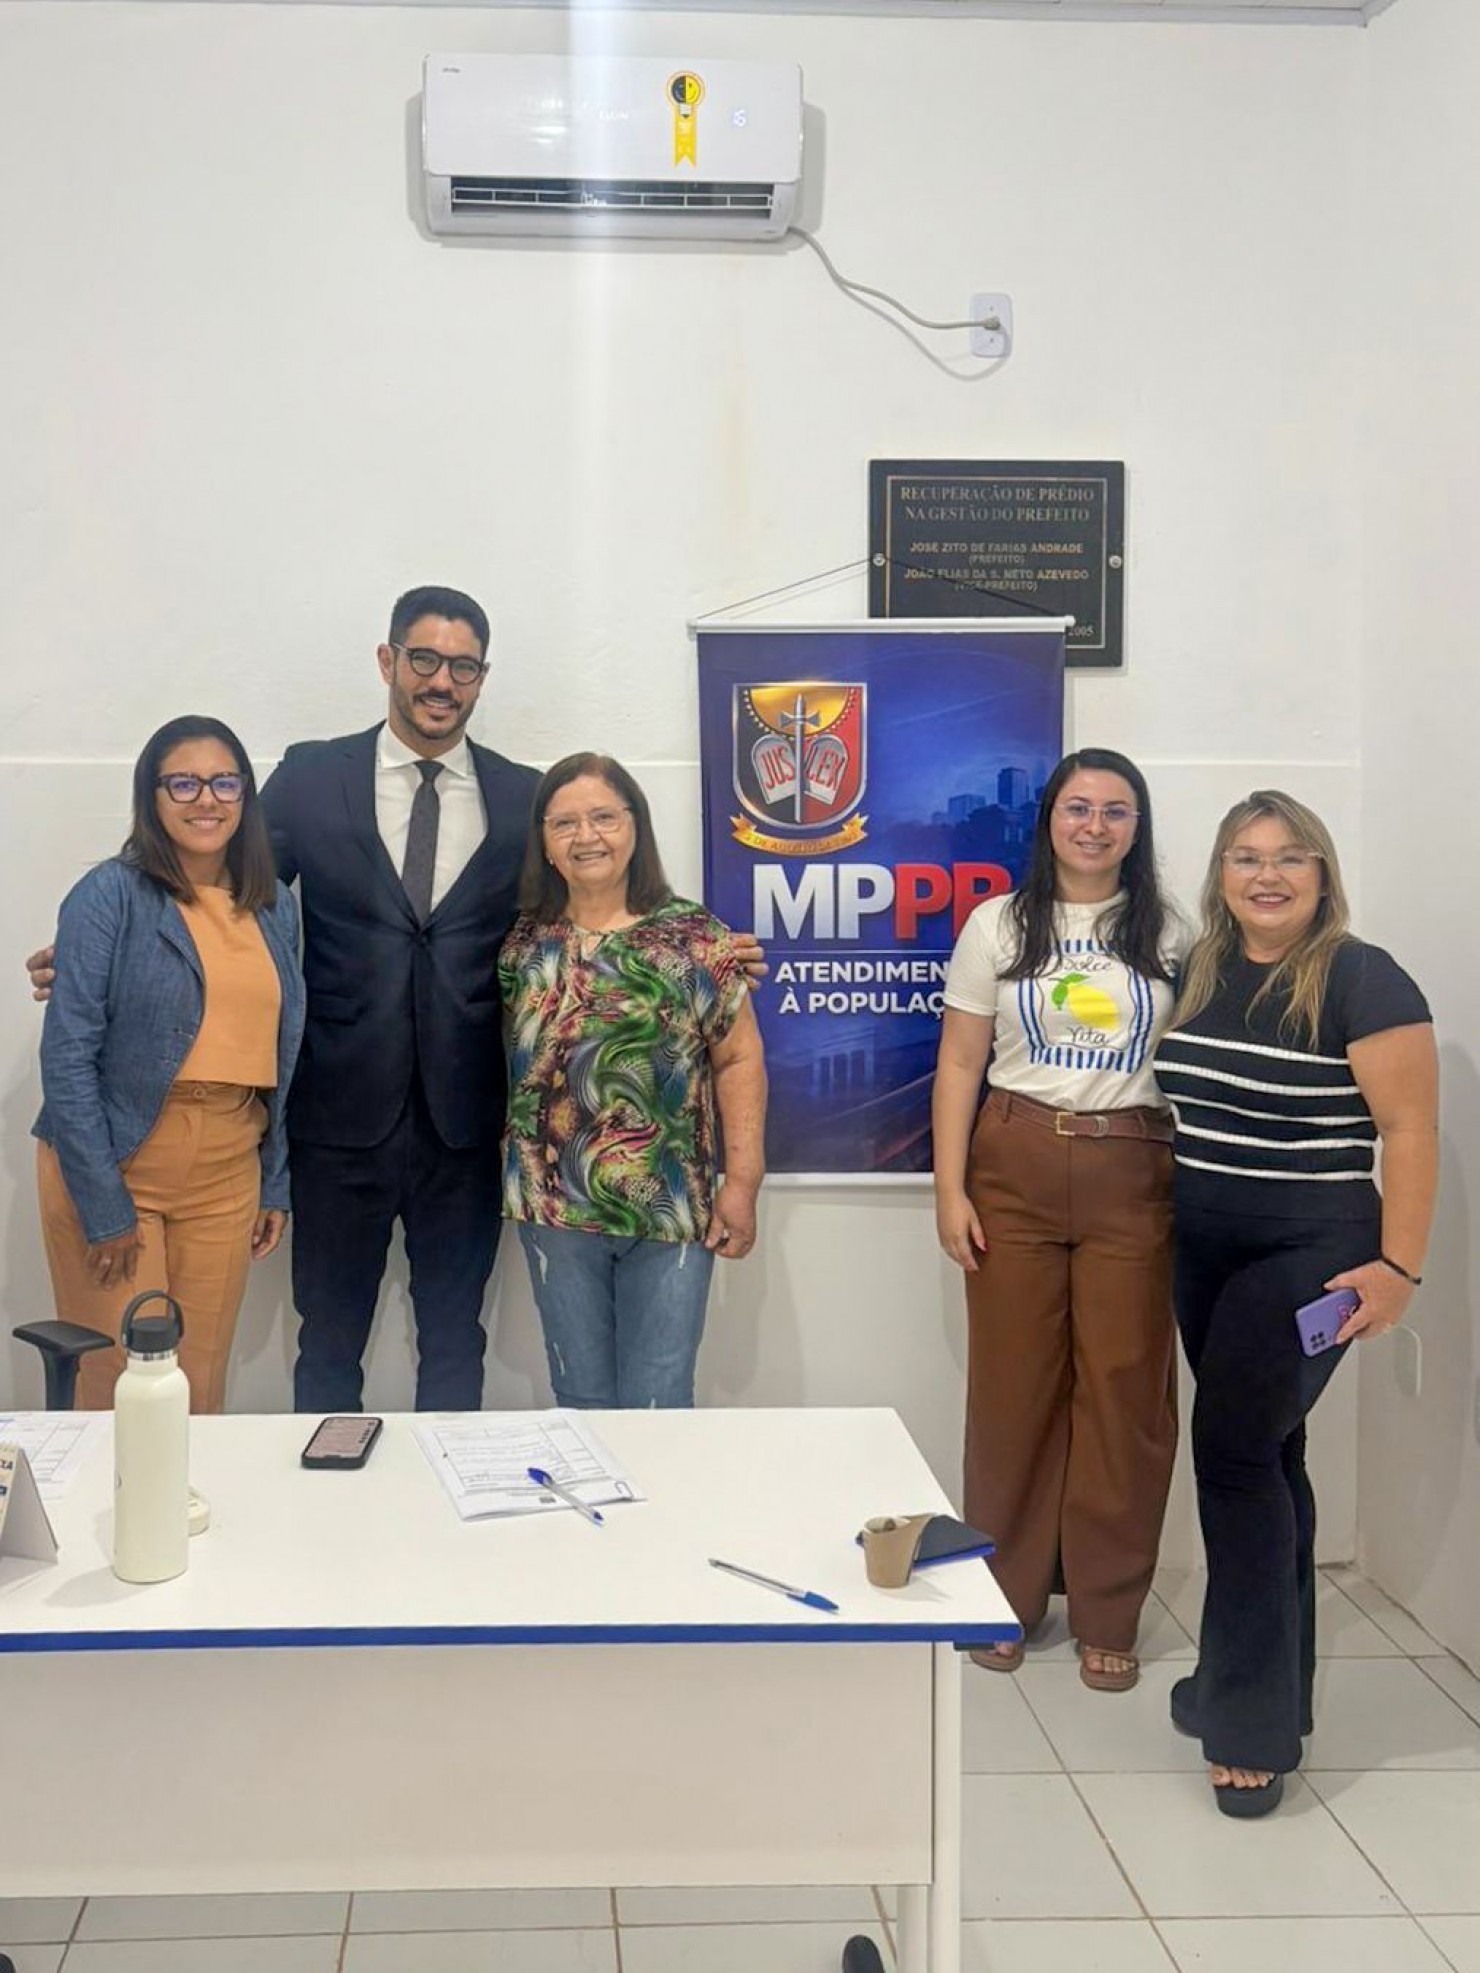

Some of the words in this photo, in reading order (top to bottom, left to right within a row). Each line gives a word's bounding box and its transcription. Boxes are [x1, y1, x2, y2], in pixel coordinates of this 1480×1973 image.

[901, 484, 1012, 503] RECUPERAÇÃO
[1015, 487, 1035, 501] DE
[1039, 483, 1094, 501] PRÉDIO
[905, 506, 925, 520] NA
[928, 504, 988, 521] GESTÃO
[992, 507, 1013, 521] DO
[1016, 507, 1089, 522] PREFEITO
[941, 542, 968, 553] ZITO
[970, 542, 985, 553] DE
[987, 542, 1026, 553] FARIAS
[1031, 542, 1084, 554] ANDRADE
[972, 568, 987, 579] DA
[1003, 568, 1034, 579] NETO
[1037, 568, 1089, 580] AZEVEDO
[761, 745, 794, 789] JUS
[806, 745, 846, 790] LEX
[775, 961, 949, 983] ATENDIMEN
[779, 987, 800, 1014] À
[808, 991, 945, 1020] POPULAÇ
